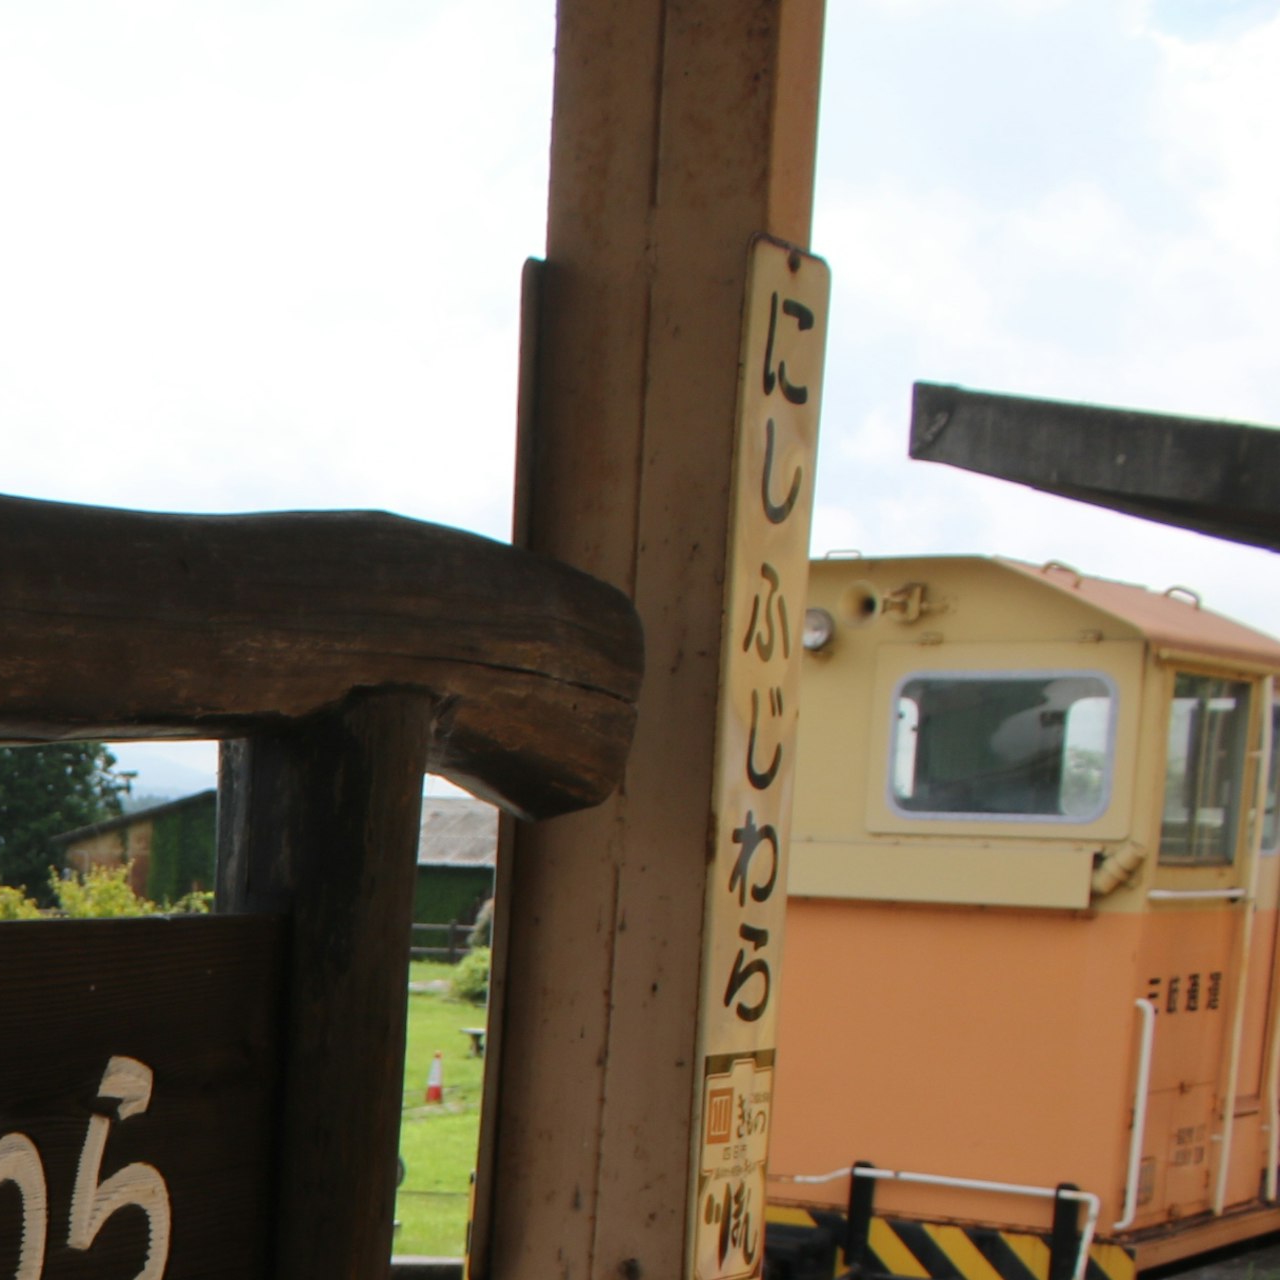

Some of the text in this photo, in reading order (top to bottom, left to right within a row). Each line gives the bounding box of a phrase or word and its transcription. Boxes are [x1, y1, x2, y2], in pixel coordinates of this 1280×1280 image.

[723, 290, 816, 1024] にしふじわら
